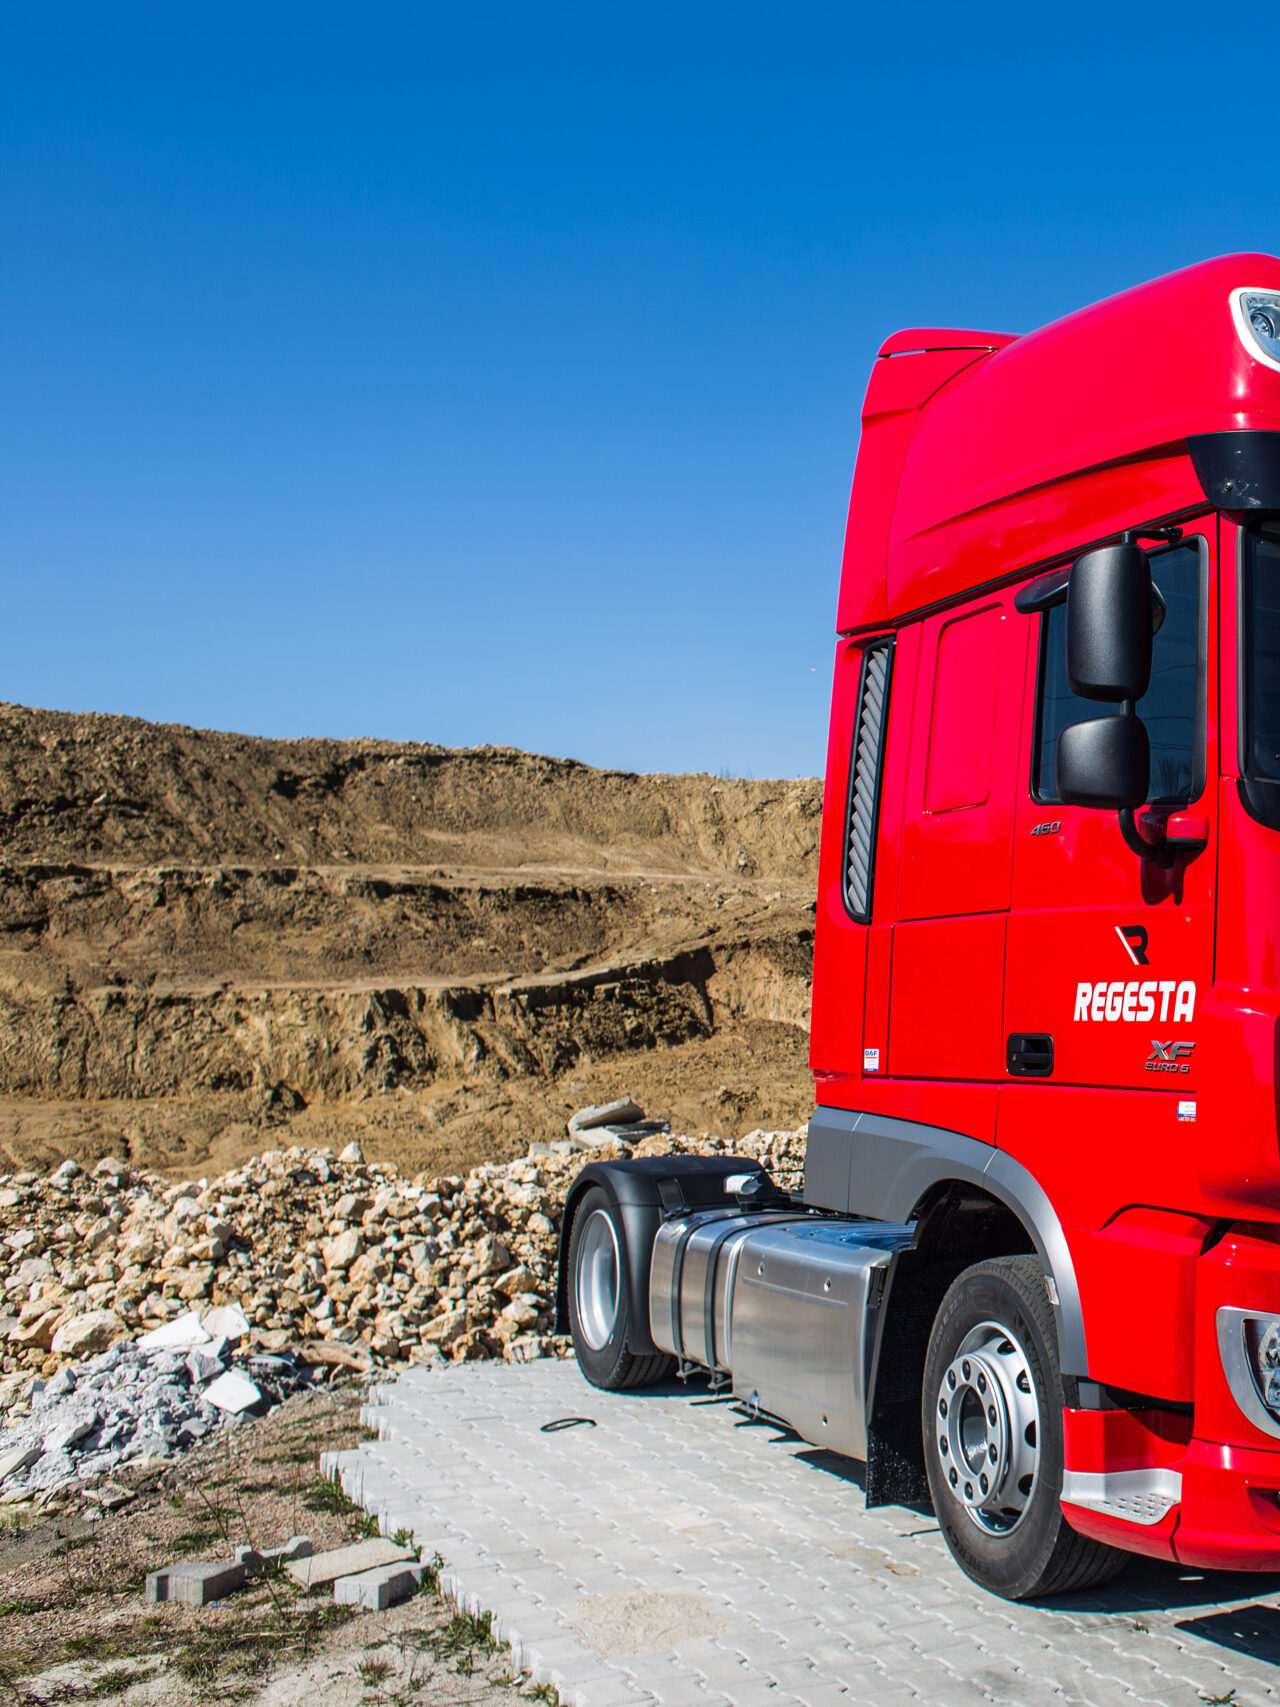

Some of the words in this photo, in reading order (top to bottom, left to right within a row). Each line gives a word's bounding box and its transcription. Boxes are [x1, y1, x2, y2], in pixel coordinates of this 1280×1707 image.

[1030, 821, 1061, 836] 460
[1073, 980, 1197, 1023] REGESTA
[1147, 1039, 1196, 1062] XF
[1144, 1061, 1179, 1073] EURO
[1180, 1064, 1191, 1074] 6
